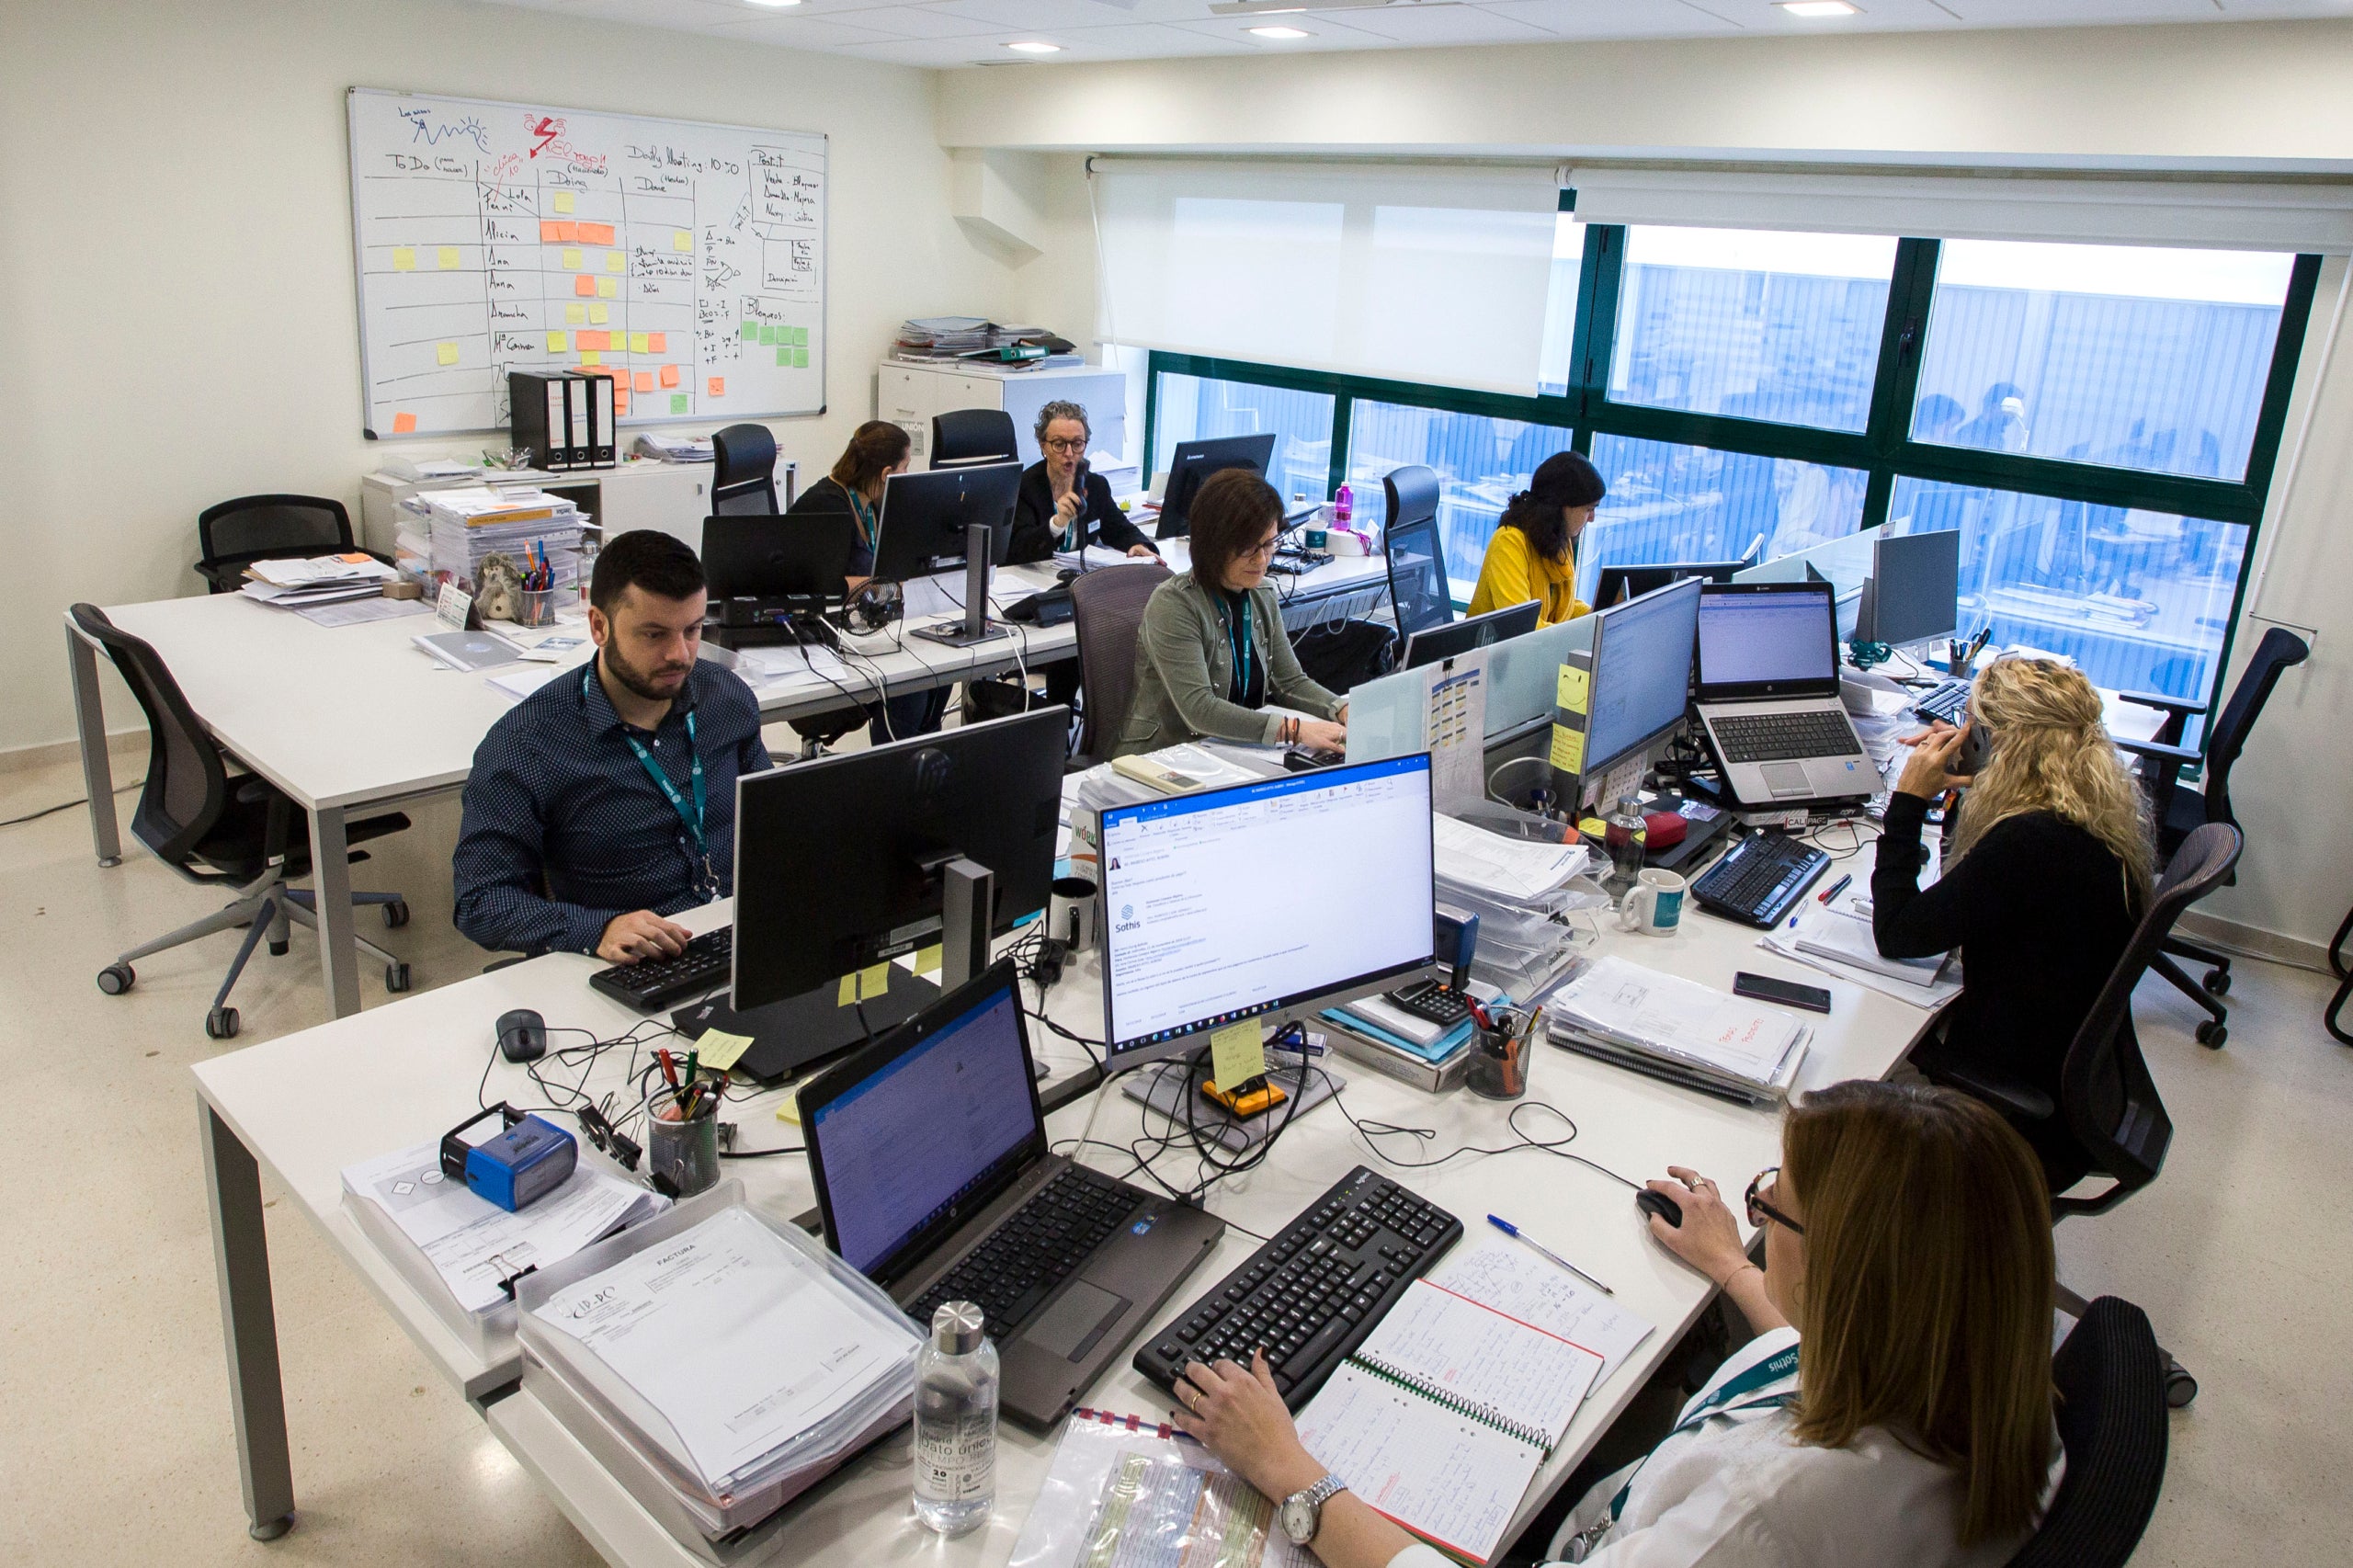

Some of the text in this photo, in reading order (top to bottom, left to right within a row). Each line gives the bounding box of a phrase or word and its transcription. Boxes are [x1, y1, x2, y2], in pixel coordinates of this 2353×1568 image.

[408, 156, 430, 171] Do
[624, 145, 663, 169] Daily
[546, 170, 588, 194] Doing
[634, 176, 666, 192] Done
[508, 187, 532, 203] Lola
[485, 218, 519, 241] Alicia
[902, 419, 924, 432] UNIÓN
[1115, 920, 1141, 933] Sothis
[656, 1244, 696, 1267] FACTURA
[1768, 1352, 1799, 1372] Sothis
[933, 1469, 947, 1478] 20
